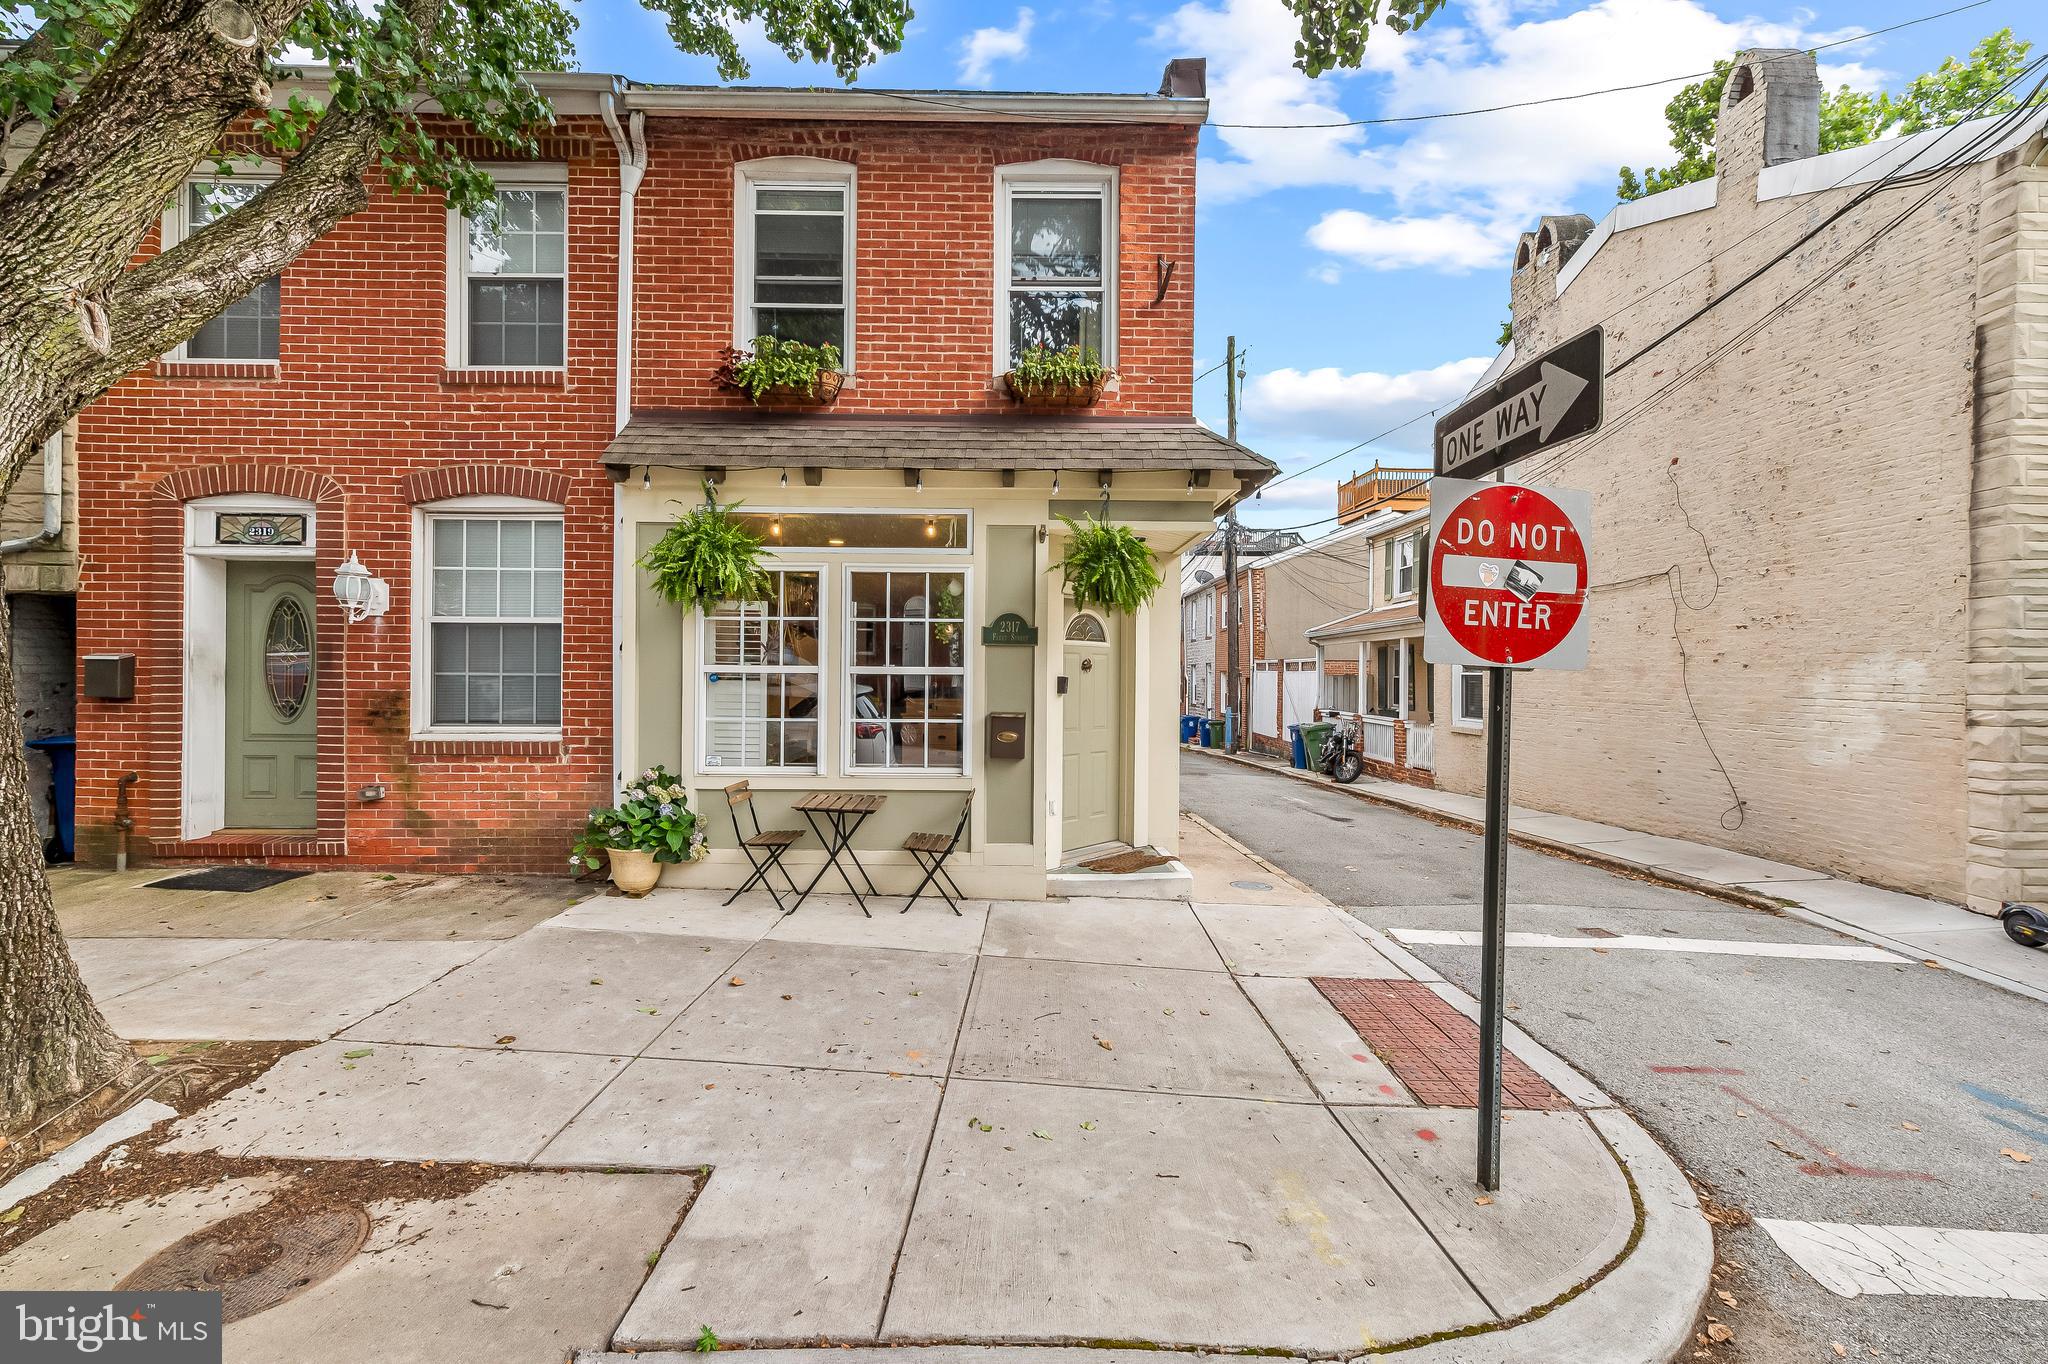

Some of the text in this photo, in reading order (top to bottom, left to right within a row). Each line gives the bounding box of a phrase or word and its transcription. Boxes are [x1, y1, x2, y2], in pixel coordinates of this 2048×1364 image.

[1447, 383, 1547, 466] ONE WAY
[249, 527, 274, 536] 2319
[1457, 518, 1566, 552] DO NOT
[1000, 621, 1020, 633] 2317
[1464, 599, 1551, 631] ENTER
